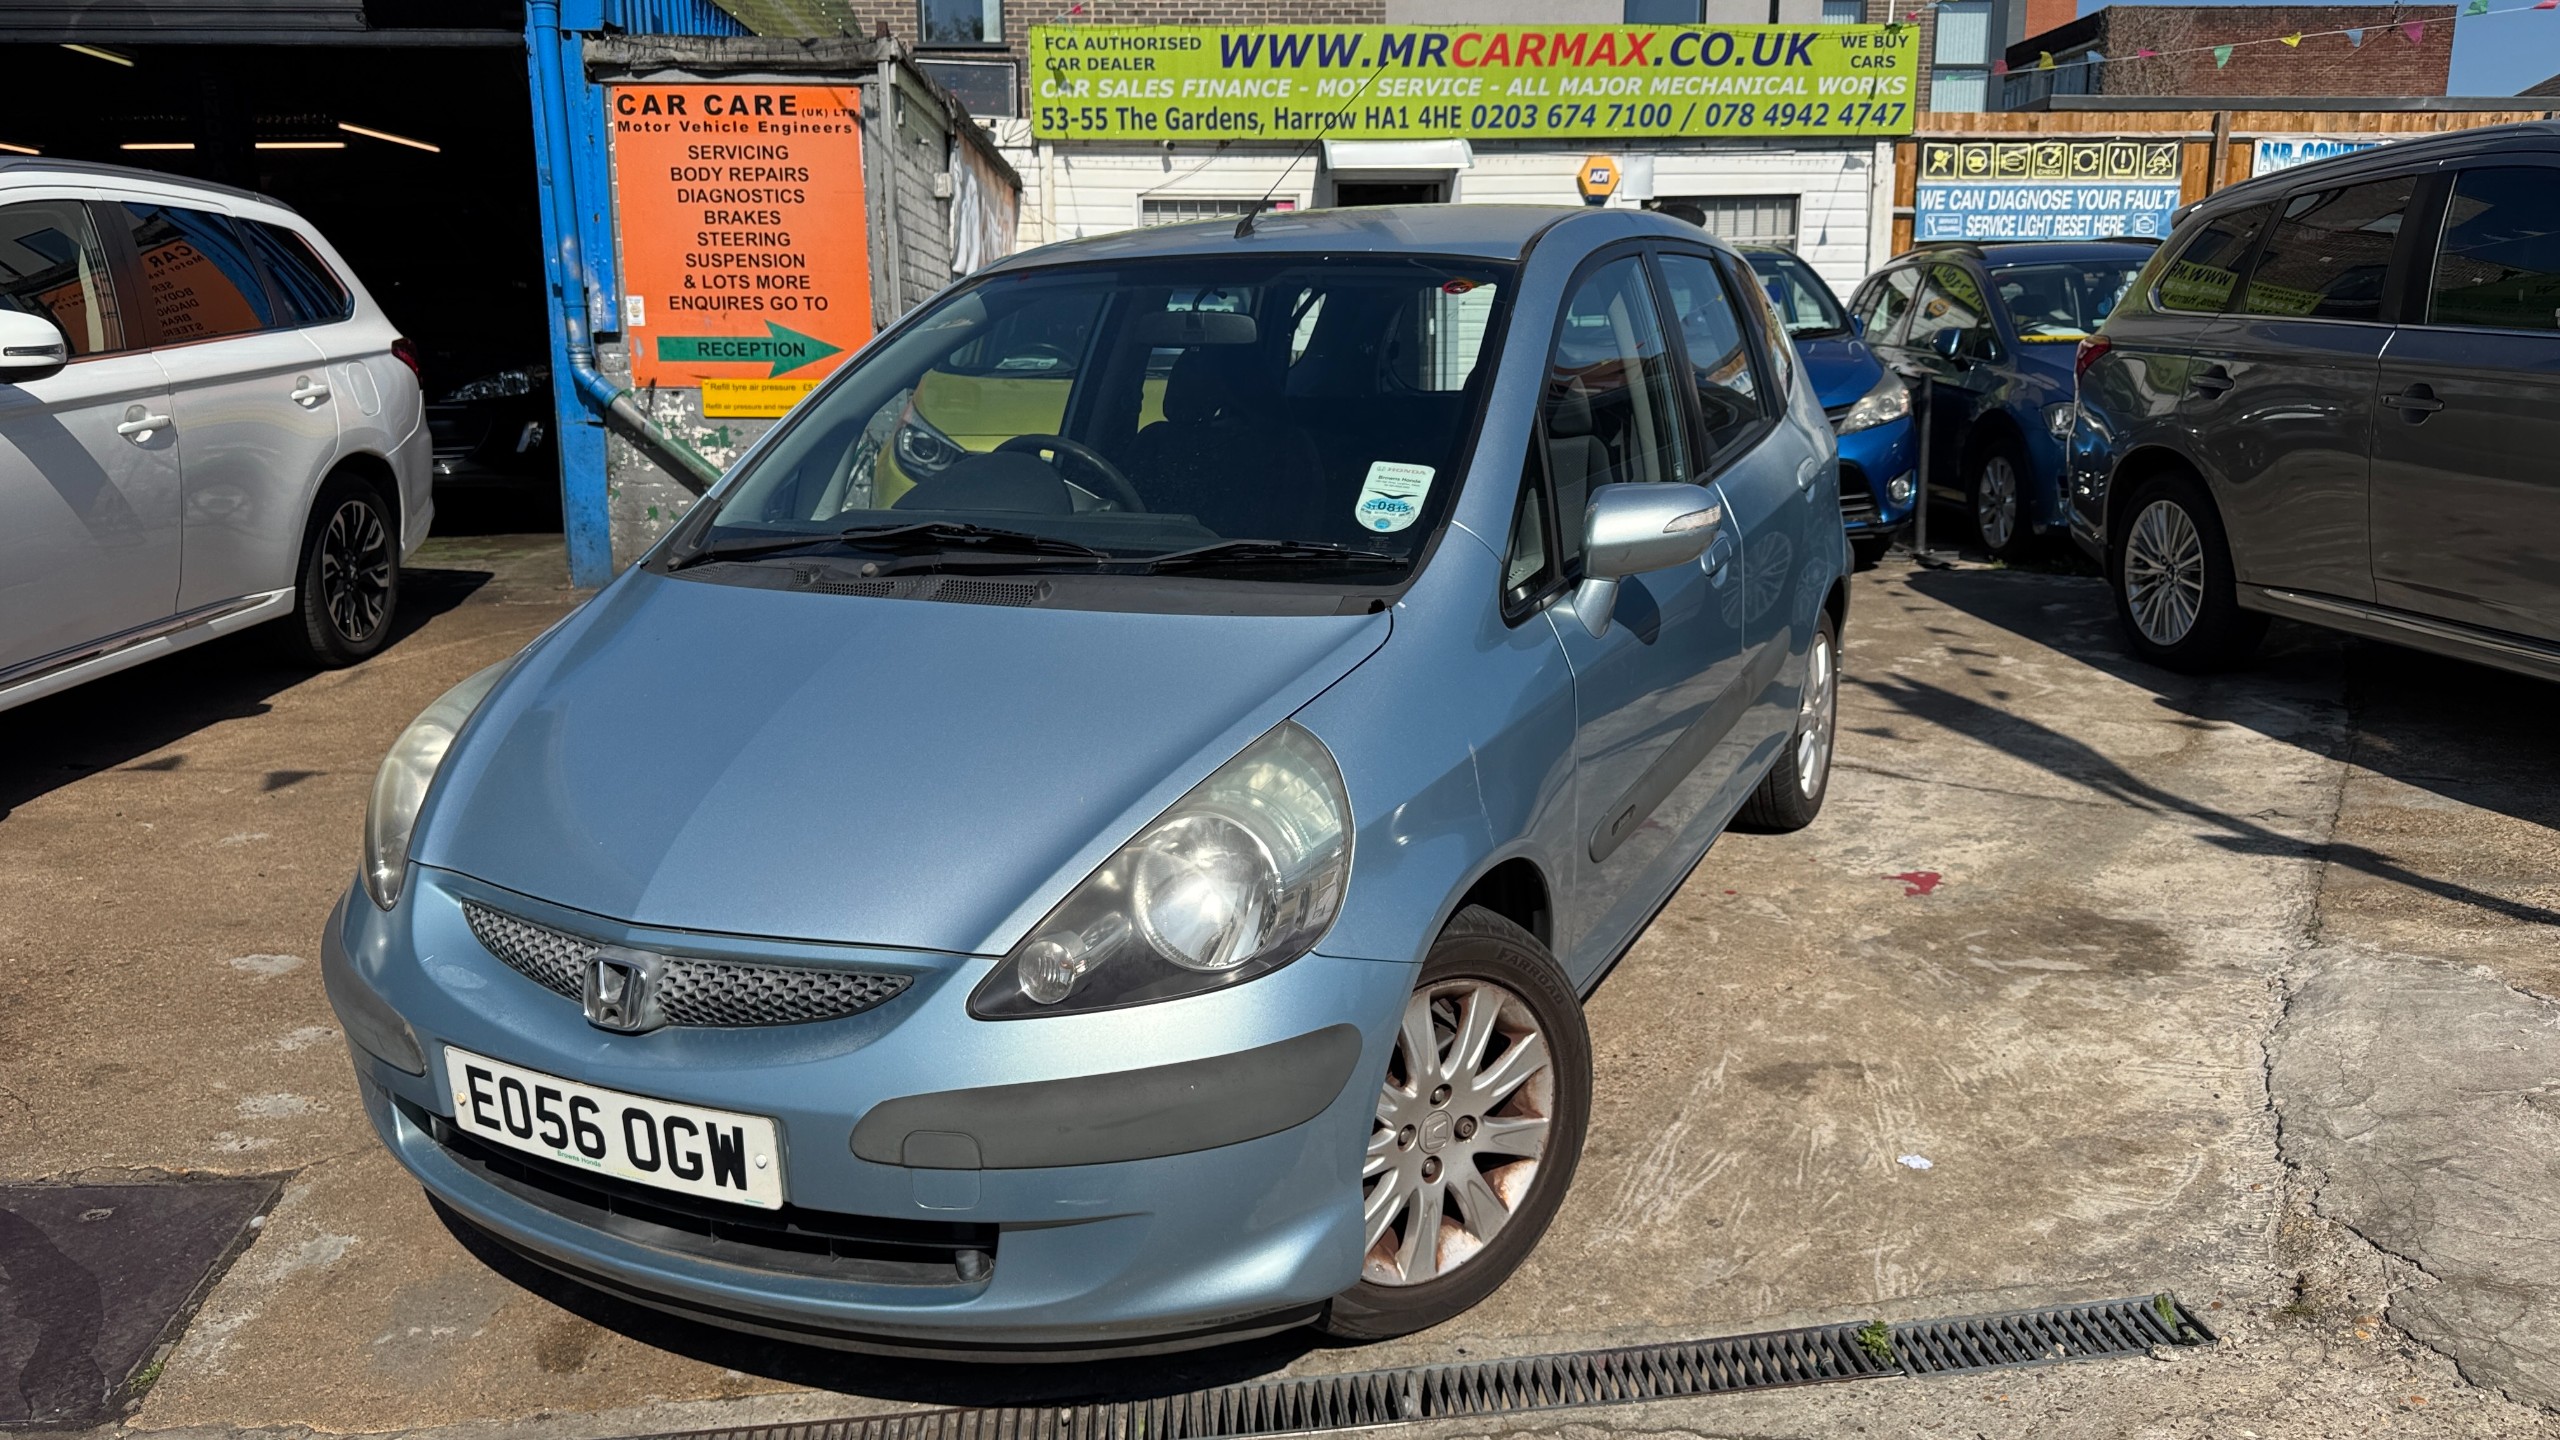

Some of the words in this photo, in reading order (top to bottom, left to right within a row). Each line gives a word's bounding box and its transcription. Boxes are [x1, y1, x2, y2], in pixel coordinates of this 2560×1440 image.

[1044, 37, 1078, 51] FCA
[1084, 37, 1202, 51] AUTHORISED
[1841, 35, 1867, 49] WE
[1874, 34, 1909, 49] BUY
[1220, 32, 1821, 69] WWW.MRCARMAX.CO.UK
[1045, 57, 1083, 71] CAR
[1088, 57, 1156, 71] DEALER
[1850, 55, 1896, 69] CARS
[1040, 78, 1094, 99] CAR
[1099, 78, 1174, 99] SALES
[1182, 78, 1292, 99] FINANCE
[1317, 78, 1367, 98] MOT
[1376, 77, 1482, 98] SERVICE
[1507, 77, 1549, 97] ALL
[1558, 77, 1641, 97] MAJOR
[1649, 76, 1809, 96] MECHANICAL
[1817, 76, 1907, 96] WORKS
[616, 93, 687, 117] CAR
[703, 94, 798, 117] CARE
[801, 108, 829, 118] (UK)
[833, 109, 856, 118] LTD
[1041, 107, 1108, 132] 53-55
[1116, 106, 1157, 132] The
[1165, 106, 1266, 136] Gardens,
[1273, 105, 1358, 132] Harrow
[1365, 105, 1409, 130] HA1
[1418, 105, 1462, 130] 4HE
[1471, 104, 1537, 129] 0203
[1547, 104, 1596, 129] 674
[1607, 103, 1673, 129] 7100
[1679, 102, 1697, 132] /
[1704, 103, 1754, 128] 078
[1762, 102, 1829, 128] 4942
[1836, 102, 1907, 128] 4747
[617, 120, 671, 133] Motor
[680, 120, 749, 133] Vehicle
[758, 121, 852, 136] Engineers
[688, 144, 789, 161] SERVICING
[670, 166, 722, 182] BODY
[729, 166, 809, 182] REPAIRS
[1590, 169, 1610, 184] ADT
[677, 188, 805, 204] DIAGNOSTICS
[1920, 189, 1947, 210] WE
[1949, 189, 1984, 210] CAN
[1987, 189, 2072, 210] DIAGNOSE
[2076, 189, 2121, 210] YOUR
[2123, 189, 2174, 210] FAULT
[704, 210, 781, 225] BRAKES
[1965, 215, 2016, 237] SERVICE
[2017, 214, 2051, 236] LIGHT
[2054, 214, 2091, 236] RESET
[2093, 214, 2127, 235] HERE
[697, 231, 791, 247] STEERING
[685, 253, 805, 268] SUSPENSION
[683, 275, 696, 289] &
[702, 275, 751, 289] LOTS
[756, 275, 811, 290] MORE
[669, 296, 765, 311] ENQUIRES
[769, 297, 798, 311] GO
[803, 297, 828, 311] TO
[697, 342, 806, 358] RECEPTION
[709, 382, 731, 390] Refill
[731, 384, 748, 392] tyre
[761, 383, 797, 392] pressure
[1377, 501, 1396, 512] 08
[465, 1063, 607, 1160] EO56
[621, 1106, 748, 1192] OGW
[557, 1149, 580, 1162] Browns
[581, 1157, 602, 1168] Honda
